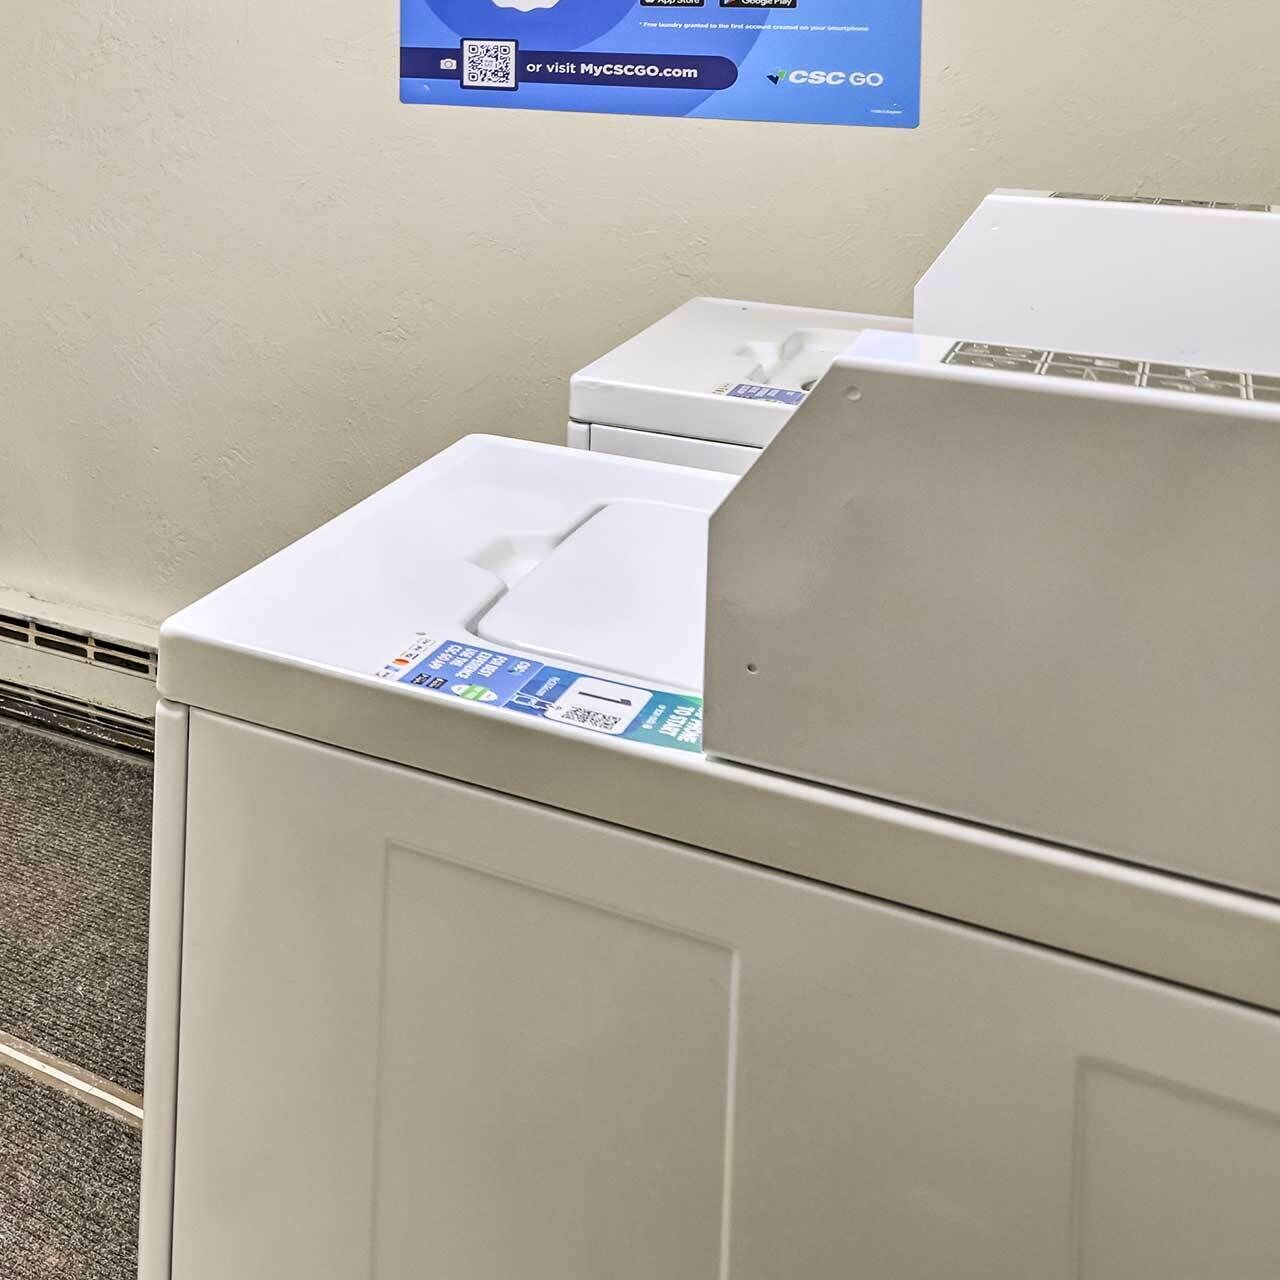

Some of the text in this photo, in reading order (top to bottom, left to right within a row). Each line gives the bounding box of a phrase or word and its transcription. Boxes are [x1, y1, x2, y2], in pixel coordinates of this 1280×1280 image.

[526, 63, 698, 78] or visit MyCSCGO.com
[789, 70, 883, 86] CSC GO
